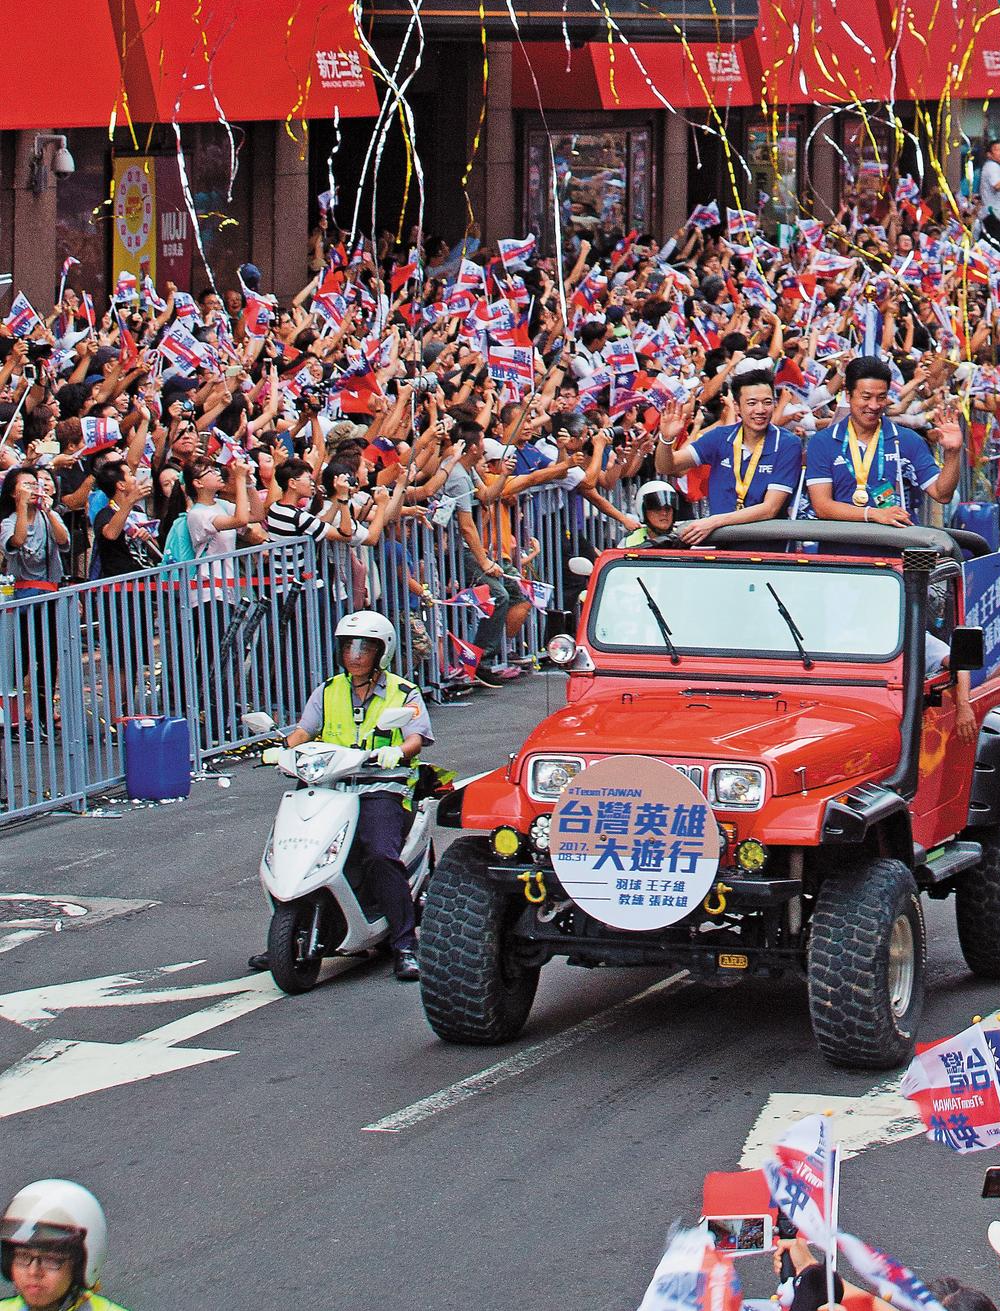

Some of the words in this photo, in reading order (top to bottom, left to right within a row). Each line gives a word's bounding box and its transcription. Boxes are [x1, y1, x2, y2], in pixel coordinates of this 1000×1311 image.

[315, 50, 363, 78] 新光三越
[162, 211, 187, 241] MUJI
[758, 464, 773, 473] TPE
[568, 787, 642, 798] #TeamTAIWAN
[558, 800, 709, 838] 台灣英雄
[560, 841, 590, 852] 2017.
[558, 853, 588, 862] 08.31
[592, 838, 704, 874] 大遊行
[616, 878, 641, 890] 羽球
[646, 879, 686, 892] 王子維
[619, 894, 645, 905] 教練
[648, 895, 689, 907] 張政雄
